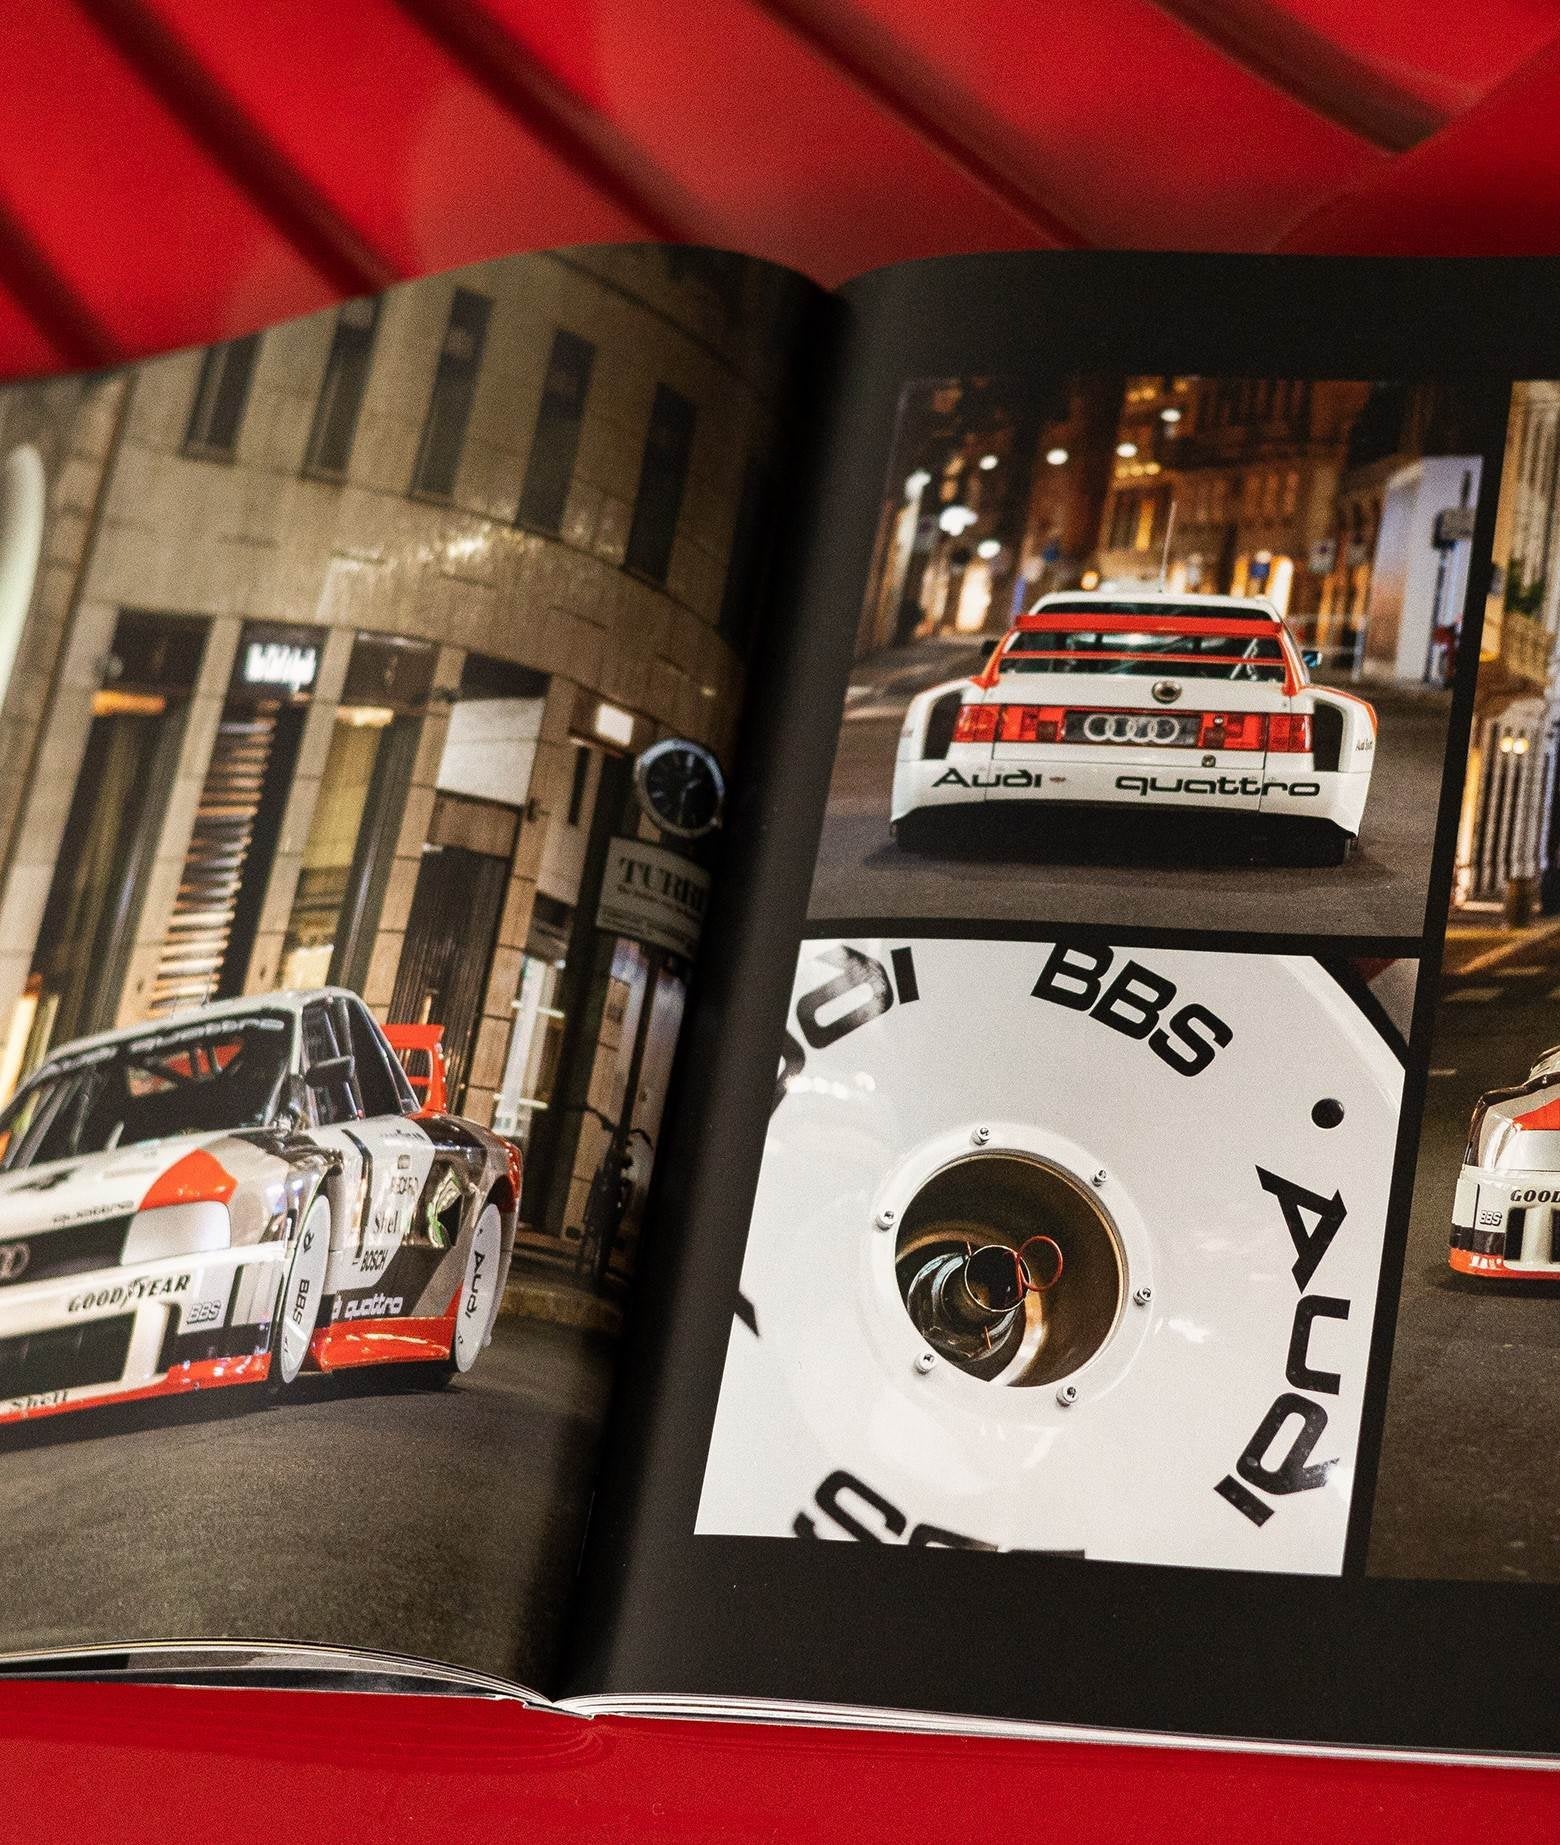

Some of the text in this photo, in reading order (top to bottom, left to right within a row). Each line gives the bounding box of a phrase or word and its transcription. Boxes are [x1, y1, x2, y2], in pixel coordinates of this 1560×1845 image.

[931, 767, 1321, 798] Audi quattro
[1030, 943, 1234, 1078] BBS
[1479, 1209, 1503, 1227] BBS
[293, 1278, 310, 1325] BBS
[465, 1250, 486, 1320] Audi
[187, 1300, 223, 1325] BBS
[344, 1292, 404, 1321] quattro
[1213, 1164, 1351, 1528] Audi
